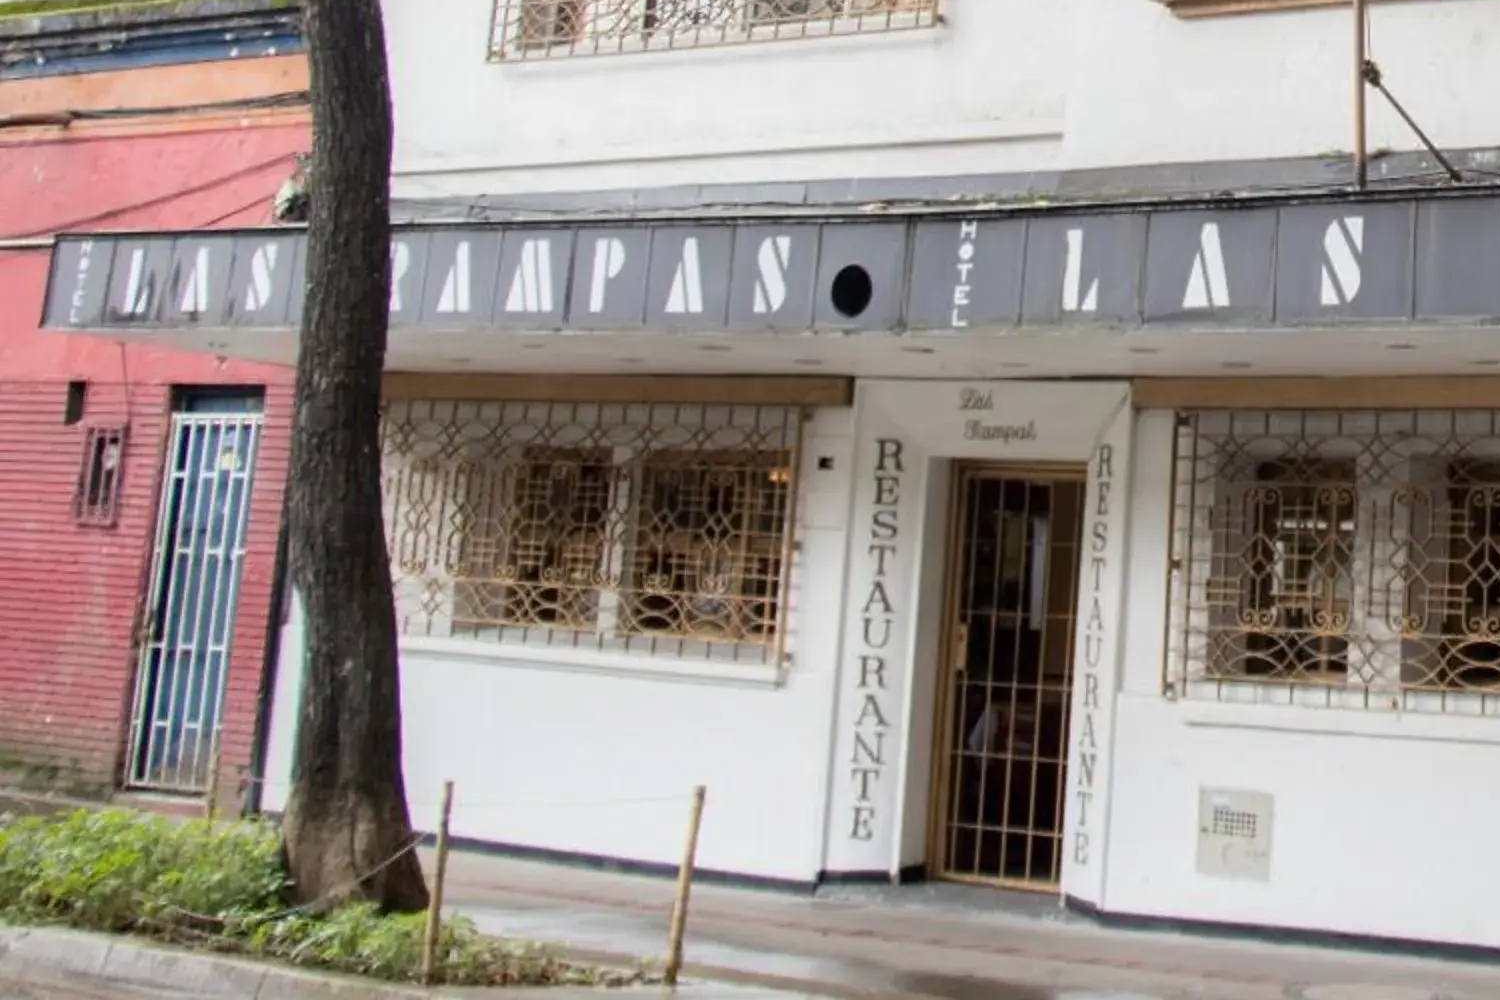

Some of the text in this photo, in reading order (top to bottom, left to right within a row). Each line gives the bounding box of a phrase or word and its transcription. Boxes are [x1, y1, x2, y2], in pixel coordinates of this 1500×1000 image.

[70, 240, 93, 324] HOTEL
[123, 243, 278, 314] LAS
[951, 220, 977, 328] HOTEL
[1062, 216, 1364, 312] LAS
[850, 438, 905, 842] RESTAURANTE
[1074, 443, 1114, 866] RESTAURANTE
